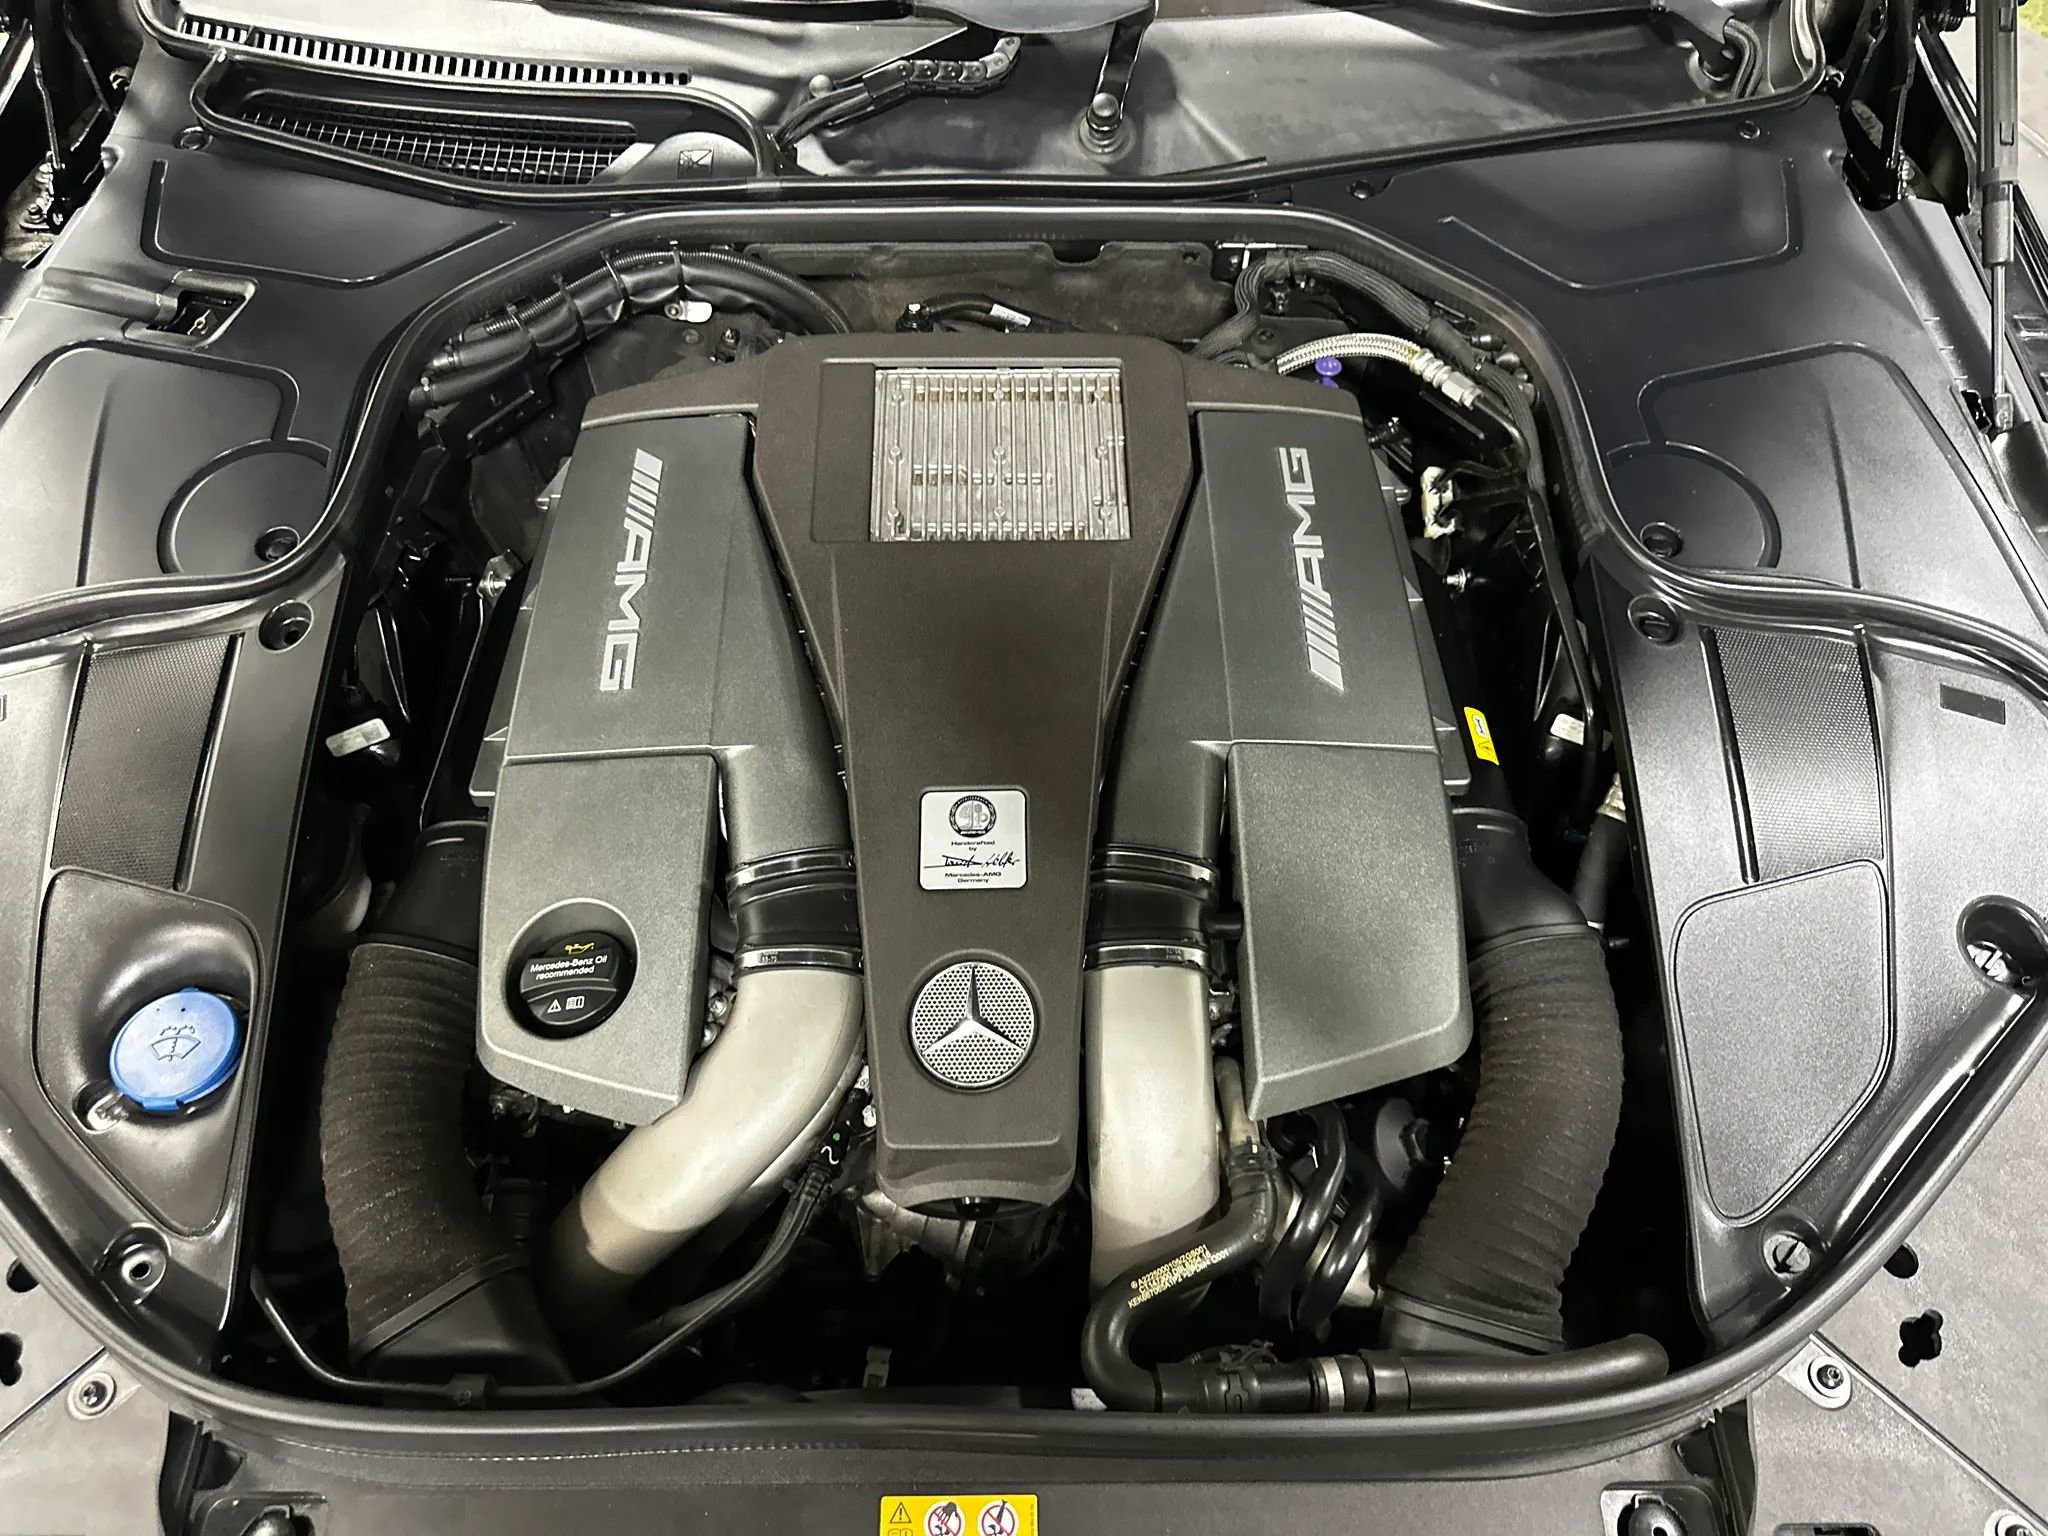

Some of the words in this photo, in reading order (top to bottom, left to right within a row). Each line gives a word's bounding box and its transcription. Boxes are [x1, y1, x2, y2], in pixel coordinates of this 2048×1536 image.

[600, 516, 652, 692] AMG
[530, 958, 594, 973] Mercedes-Benz
[595, 955, 608, 963] Oil
[535, 966, 595, 980] recommended
